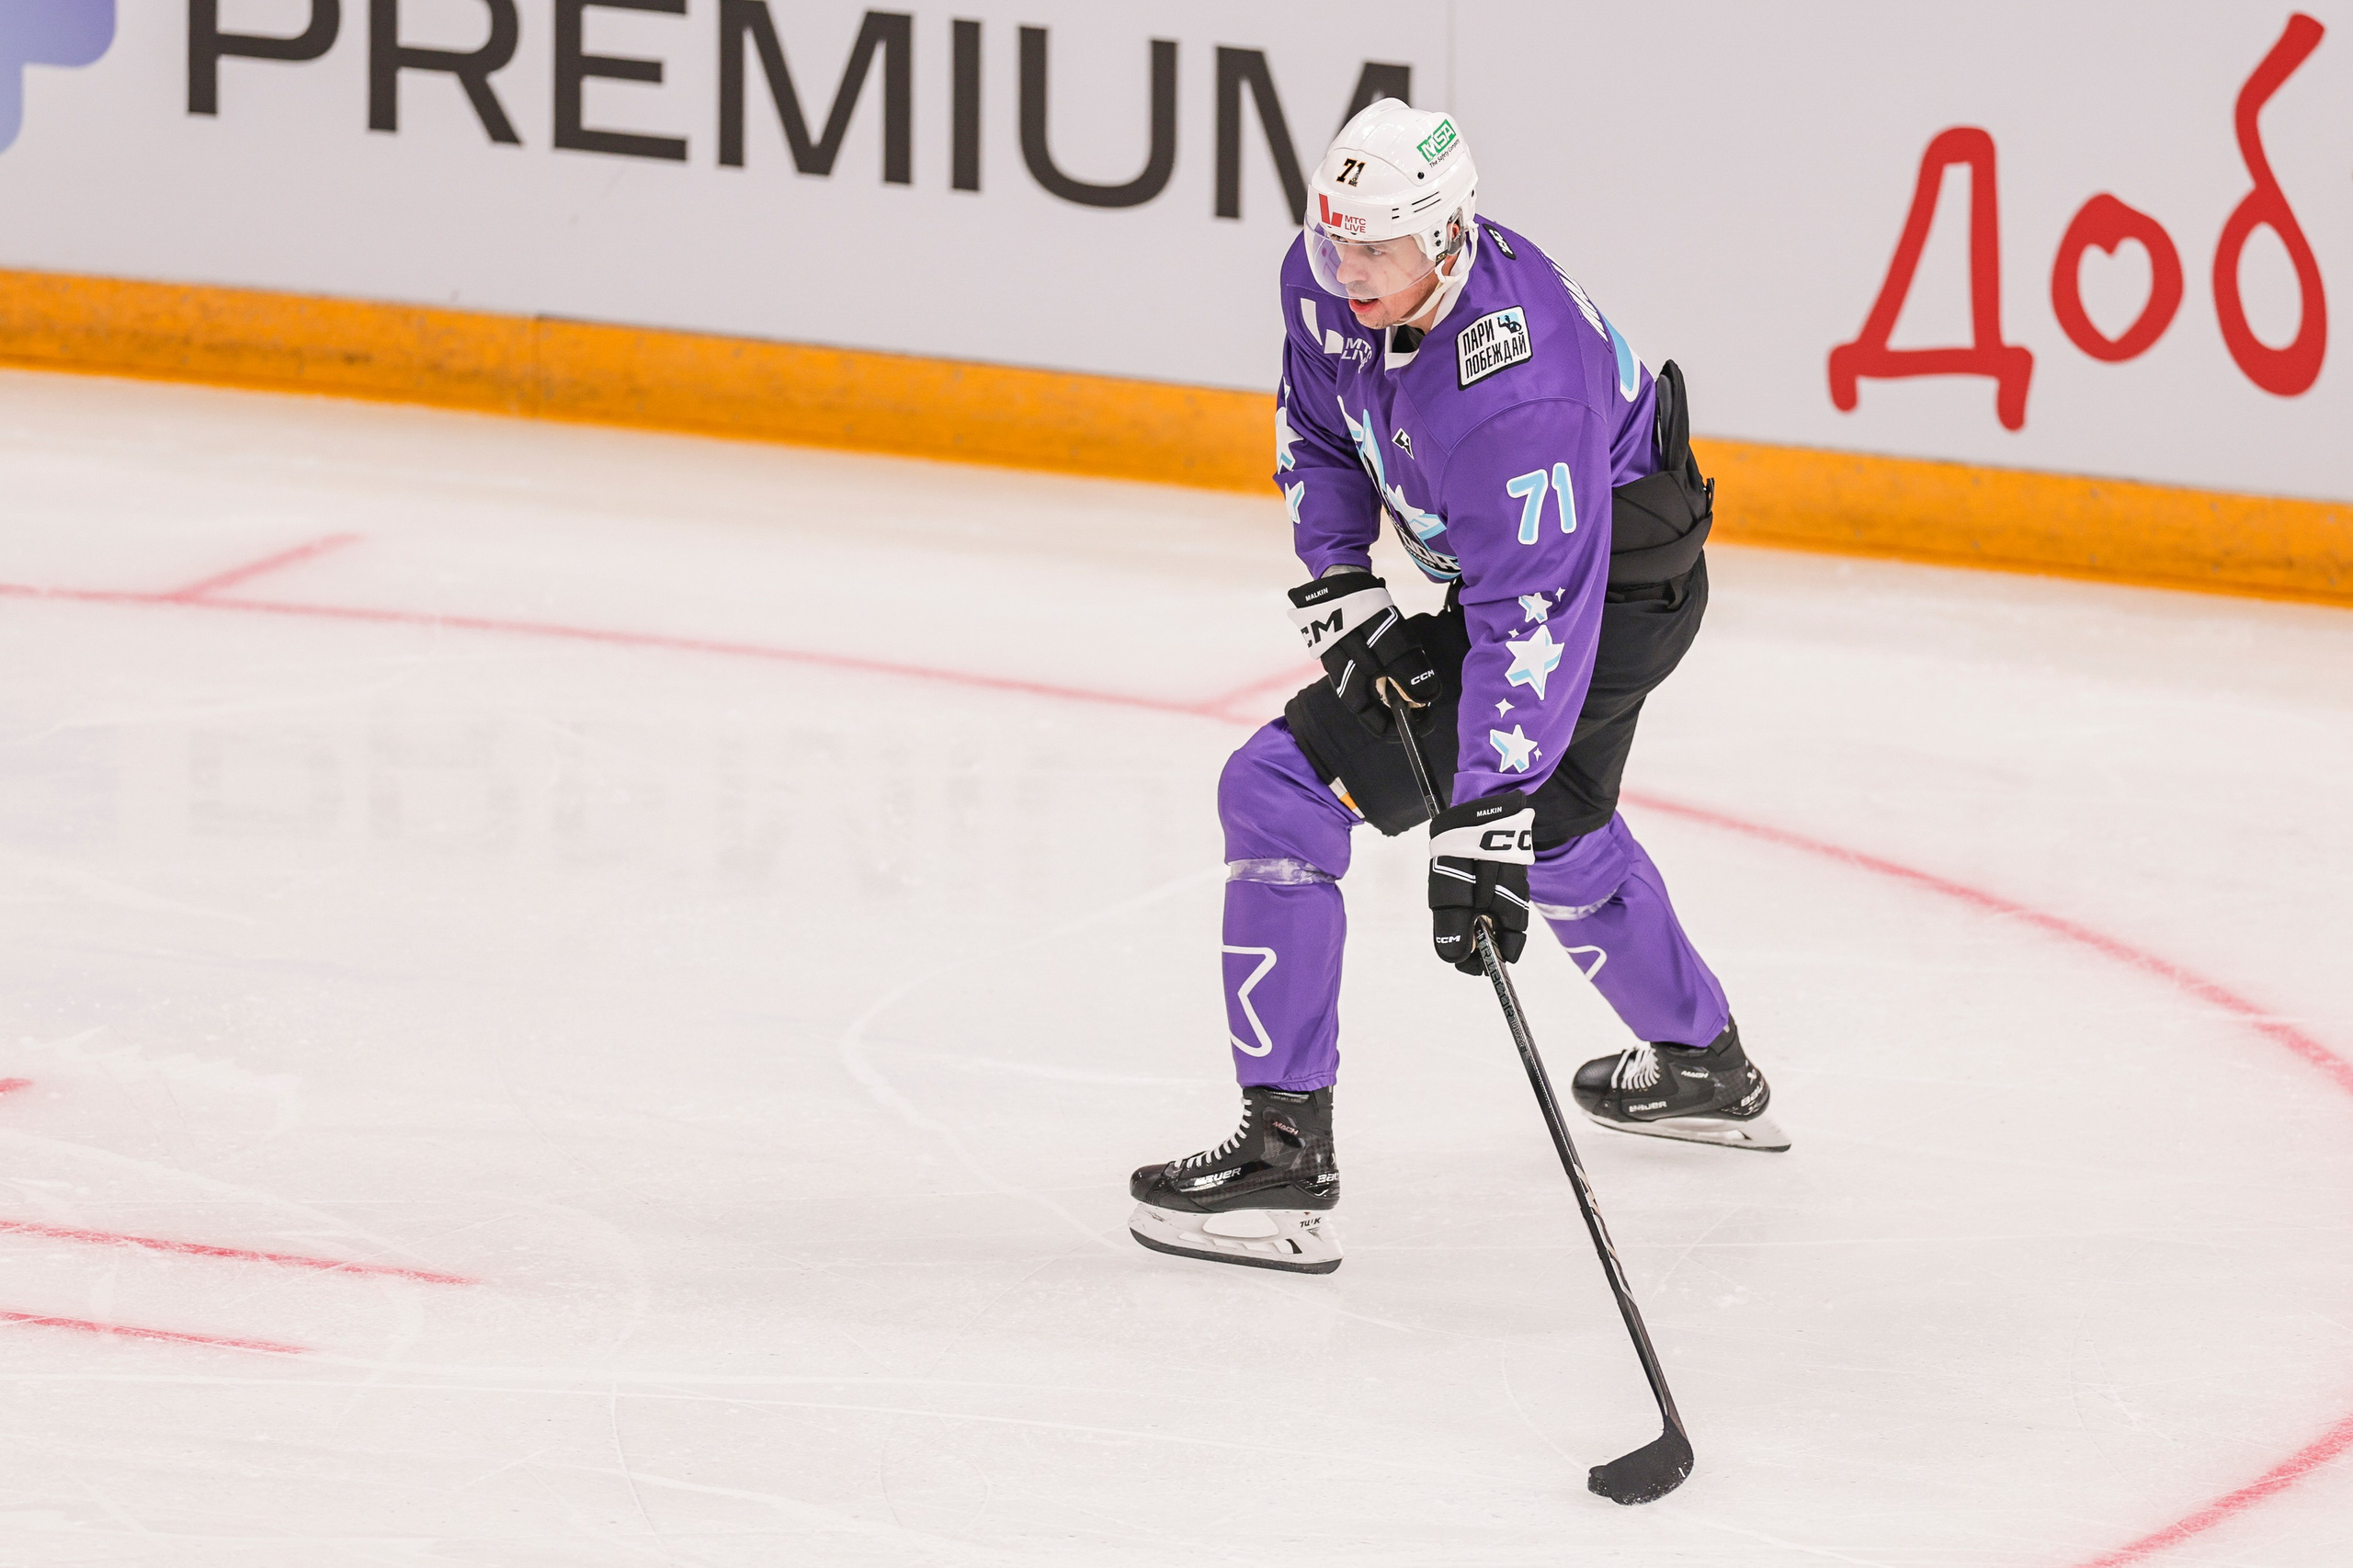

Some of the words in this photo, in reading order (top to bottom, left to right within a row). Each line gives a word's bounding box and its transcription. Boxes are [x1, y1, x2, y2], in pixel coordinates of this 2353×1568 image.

[187, 0, 1413, 223] PREMIUM
[1419, 121, 1455, 161] MSA
[1336, 157, 1366, 187] 71
[1344, 222, 1367, 233] LIVE
[1828, 10, 2327, 432] Доб
[1462, 318, 1495, 357] ПАРИ
[1465, 331, 1528, 380] ПОБЕЖДАЙ
[1506, 461, 1577, 546] 71
[1304, 586, 1329, 602] MALKIN
[1410, 669, 1435, 686] CCM
[1476, 806, 1503, 817] MALKIN
[1436, 935, 1461, 944] CCM
